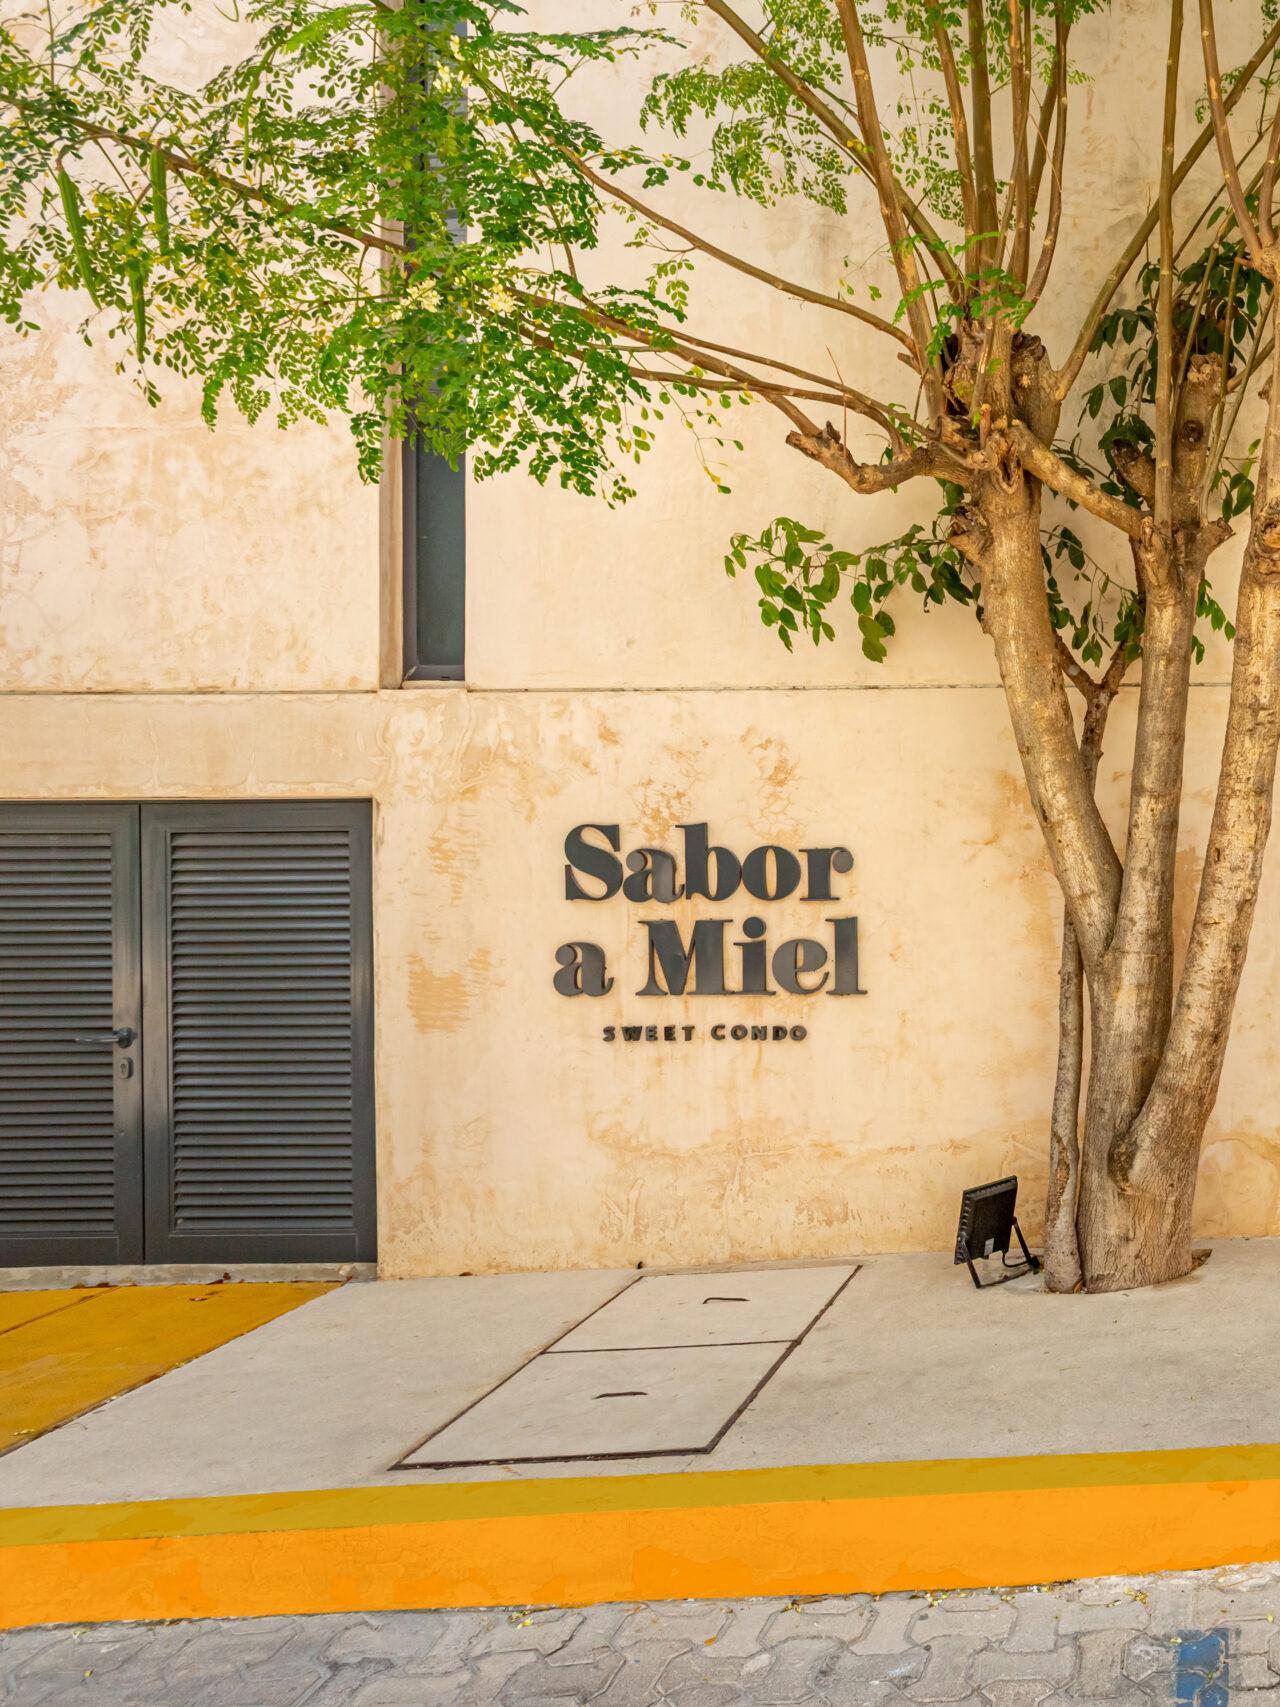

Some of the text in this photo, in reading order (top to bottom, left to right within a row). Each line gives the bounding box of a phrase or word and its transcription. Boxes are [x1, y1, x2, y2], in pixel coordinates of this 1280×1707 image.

[564, 822, 854, 904] Sabor
[553, 916, 868, 998] a Miel
[602, 1024, 808, 1042] SWEET CONDO
